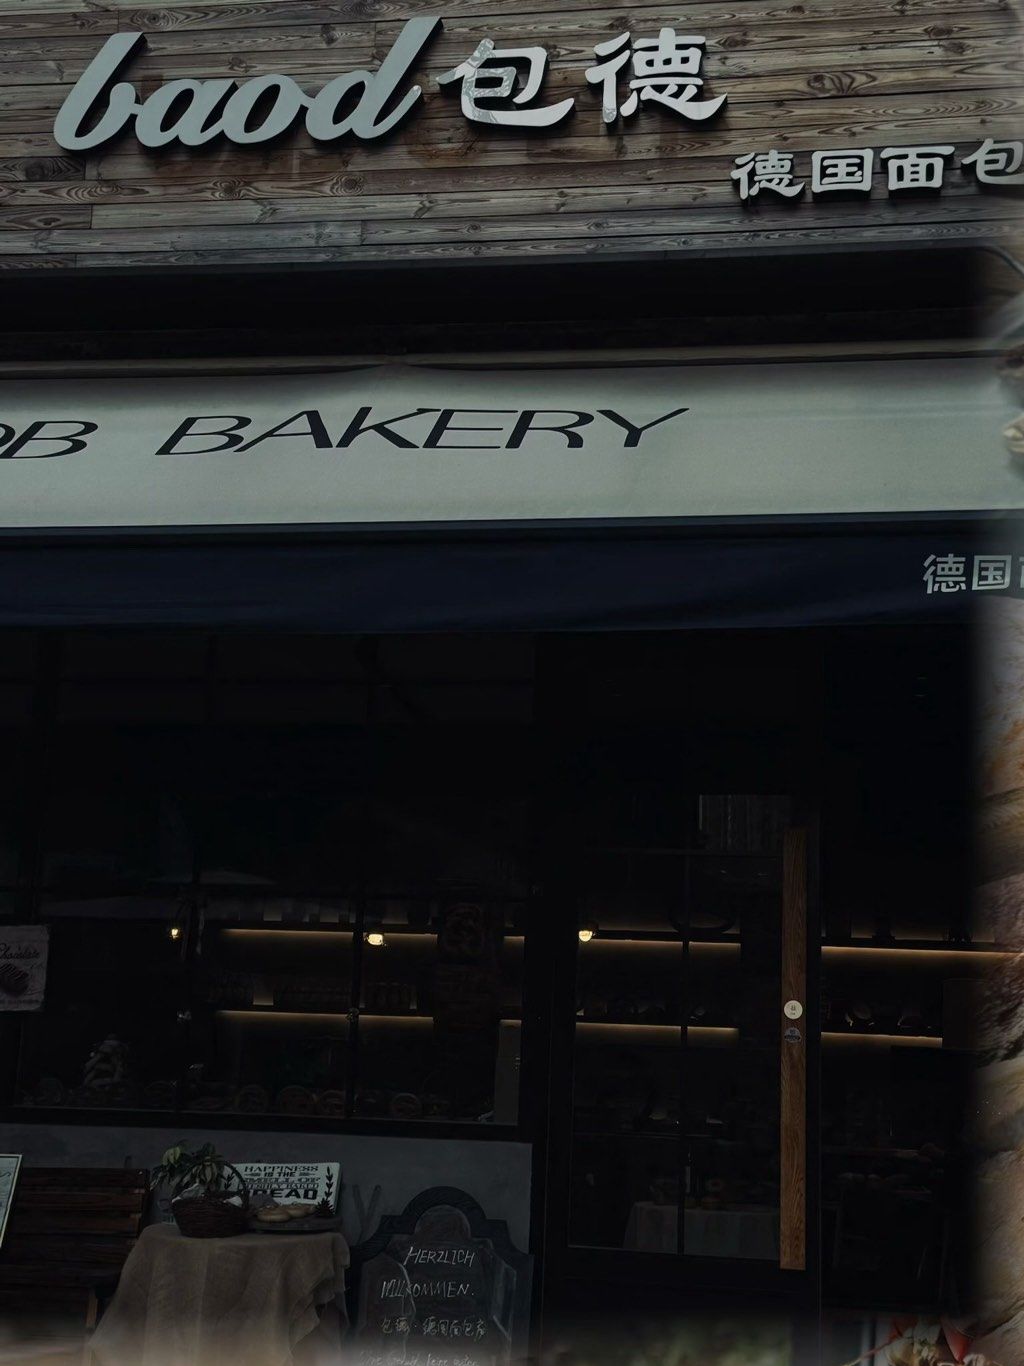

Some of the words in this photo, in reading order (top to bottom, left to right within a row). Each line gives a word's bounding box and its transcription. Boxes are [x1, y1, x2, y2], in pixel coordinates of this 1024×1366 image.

[53, 14, 446, 153] baod
[435, 26, 729, 130] 包德
[0, 420, 100, 460] B
[155, 406, 690, 457] BAKERY
[403, 1246, 475, 1267] HERZLICH
